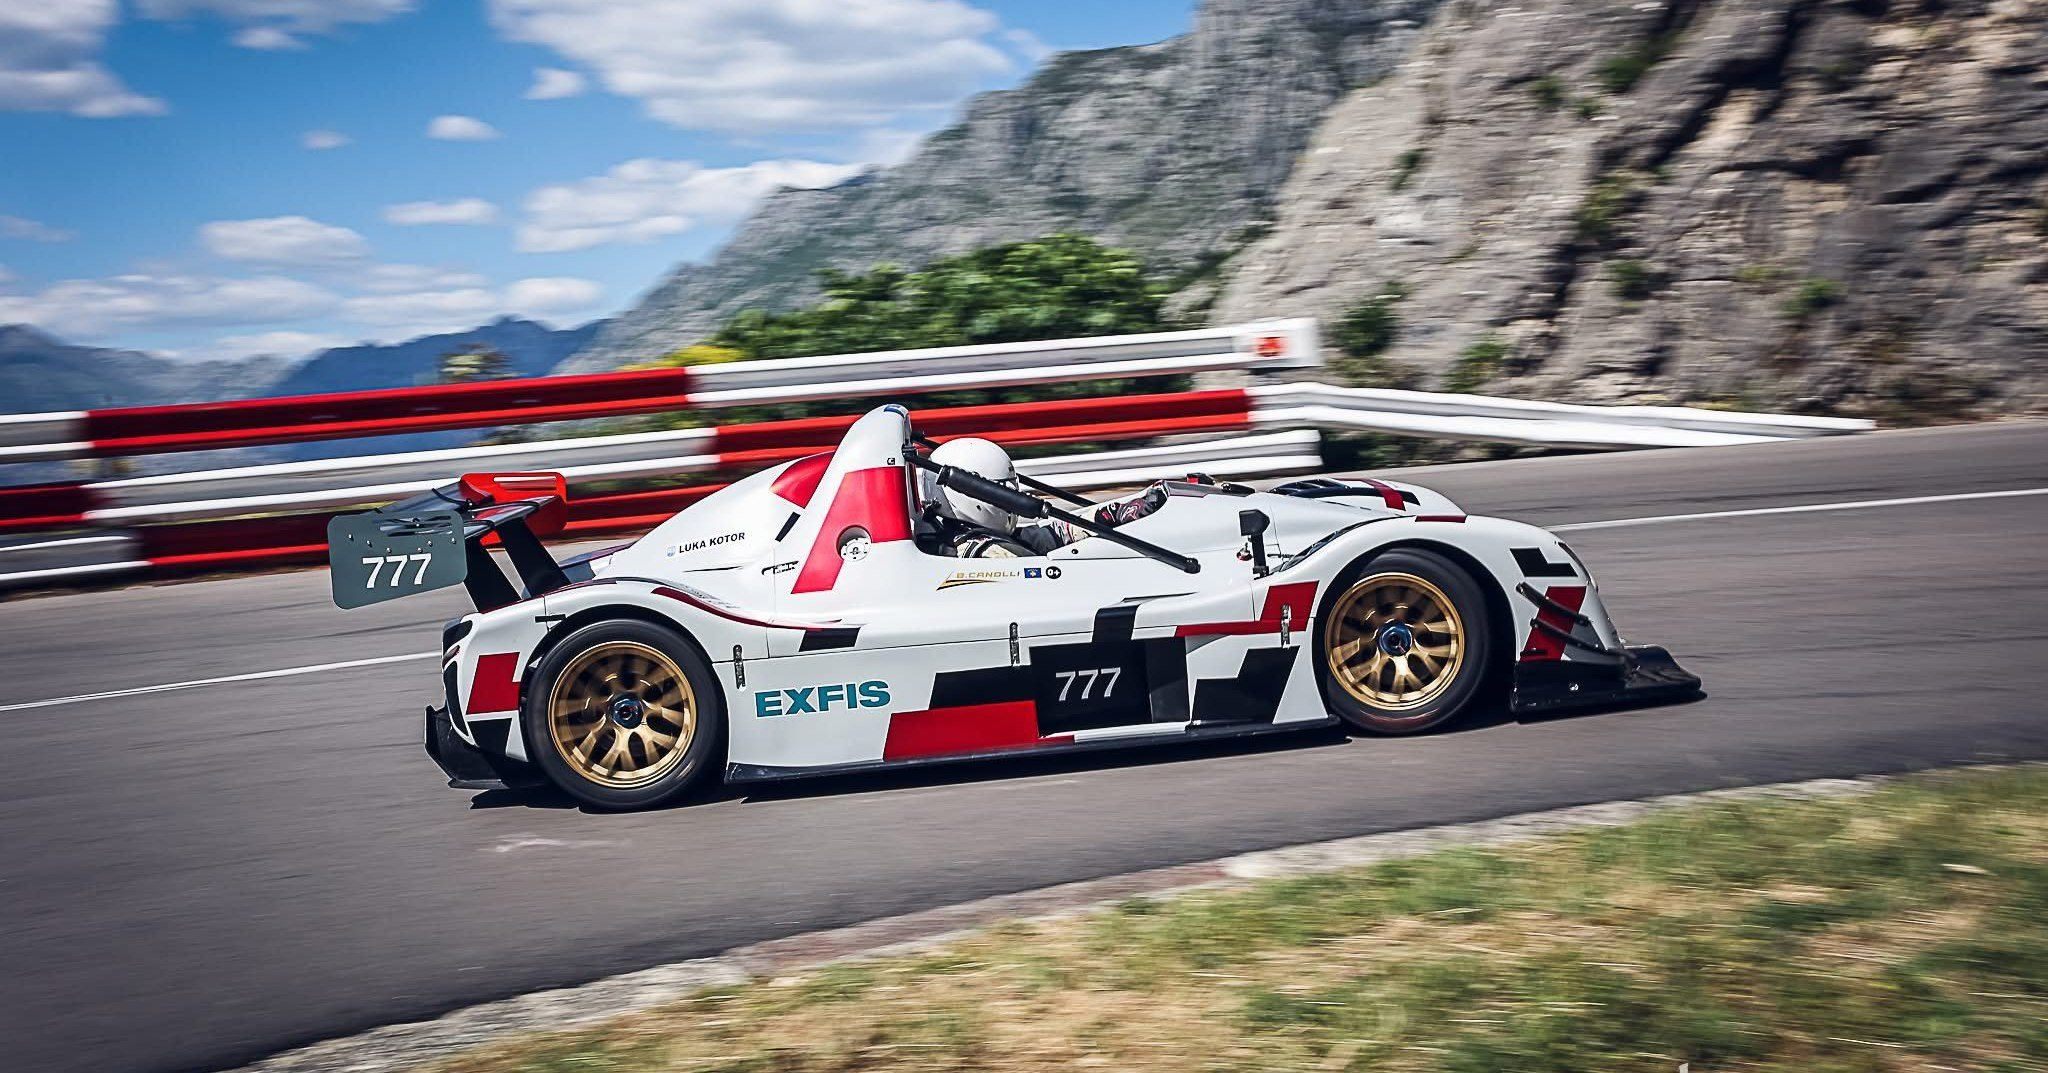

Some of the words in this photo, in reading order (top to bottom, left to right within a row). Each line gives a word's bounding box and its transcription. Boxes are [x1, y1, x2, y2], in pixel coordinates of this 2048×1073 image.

[680, 541, 707, 554] LUKA
[709, 532, 745, 546] KOTOR
[362, 552, 432, 589] 777
[755, 680, 891, 718] EXFIS
[1055, 667, 1122, 702] 777
